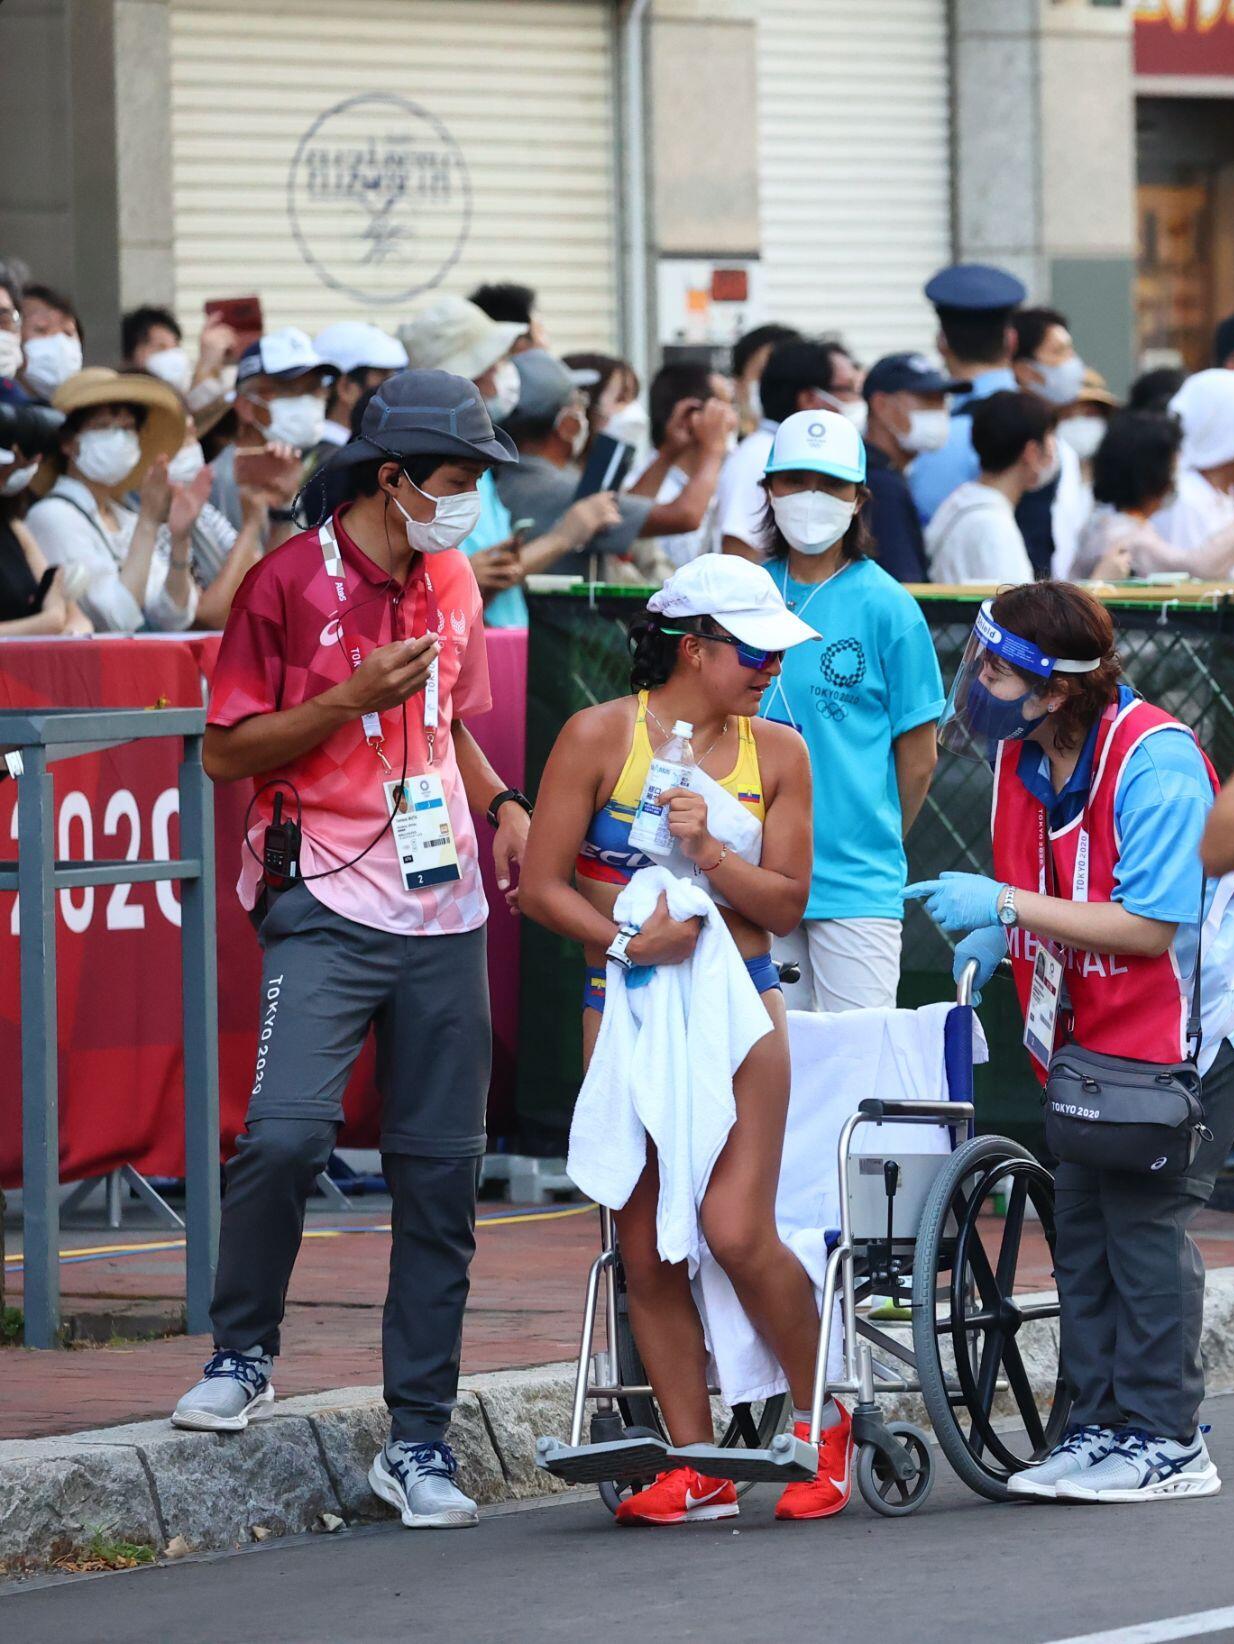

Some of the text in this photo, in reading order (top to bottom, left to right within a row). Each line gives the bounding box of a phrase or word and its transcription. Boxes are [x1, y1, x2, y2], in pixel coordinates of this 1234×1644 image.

[351, 647, 362, 668] TOK
[810, 685, 839, 700] TOKYO
[10, 787, 182, 936] 020
[1076, 835, 1088, 892] TOKYO 2020
[417, 874, 425, 884] 2
[251, 974, 284, 1095] TOKYO 2020
[1051, 1101, 1100, 1119] TOKYO 2020
